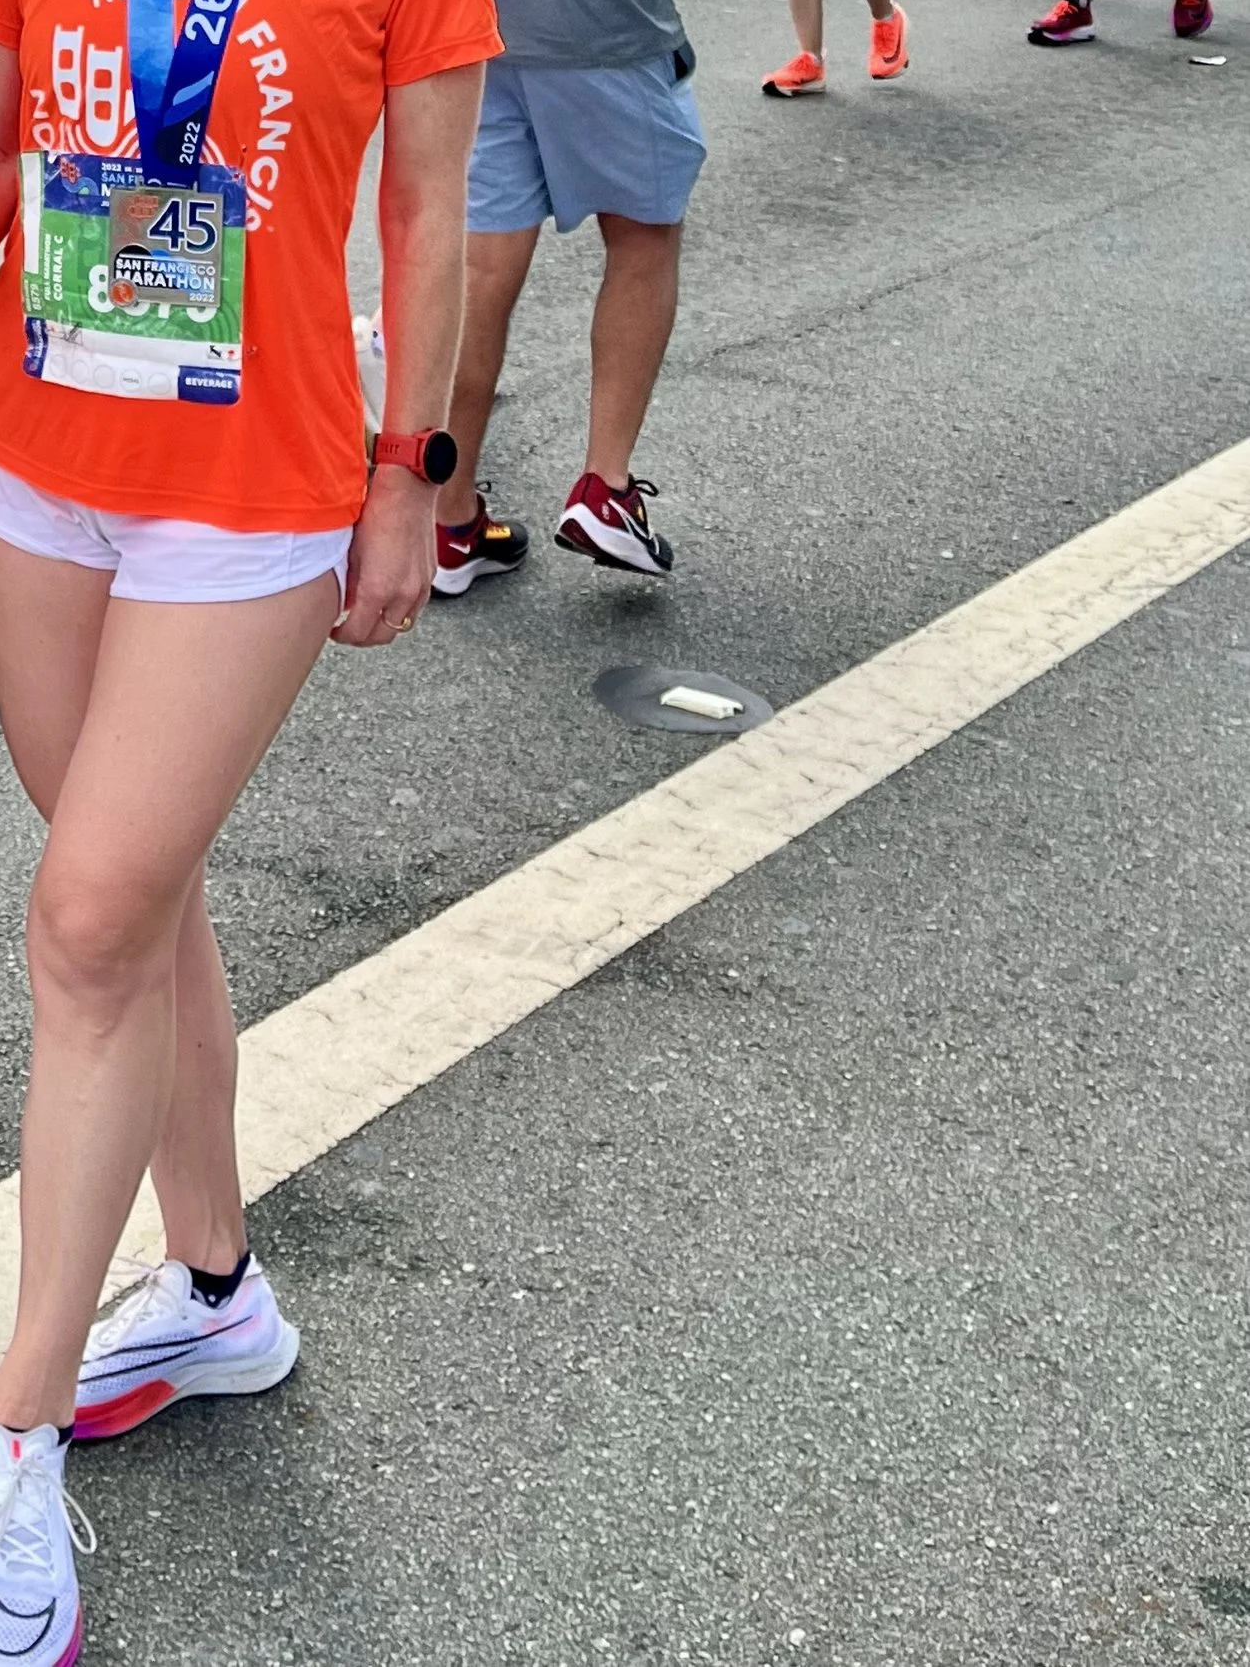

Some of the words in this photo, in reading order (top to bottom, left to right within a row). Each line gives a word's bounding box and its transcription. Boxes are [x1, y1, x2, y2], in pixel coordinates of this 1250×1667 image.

[236, 19, 294, 232] FRANCI
[179, 121, 201, 165] 2022
[147, 197, 218, 254] 45
[53, 235, 64, 245] C
[53, 247, 64, 301] CORRAL
[115, 258, 142, 271] SAN
[143, 261, 216, 277] FRANCISCO
[114, 270, 216, 291] MARATHON
[190, 292, 215, 303] 2022
[185, 377, 234, 389] BEVERAGE
